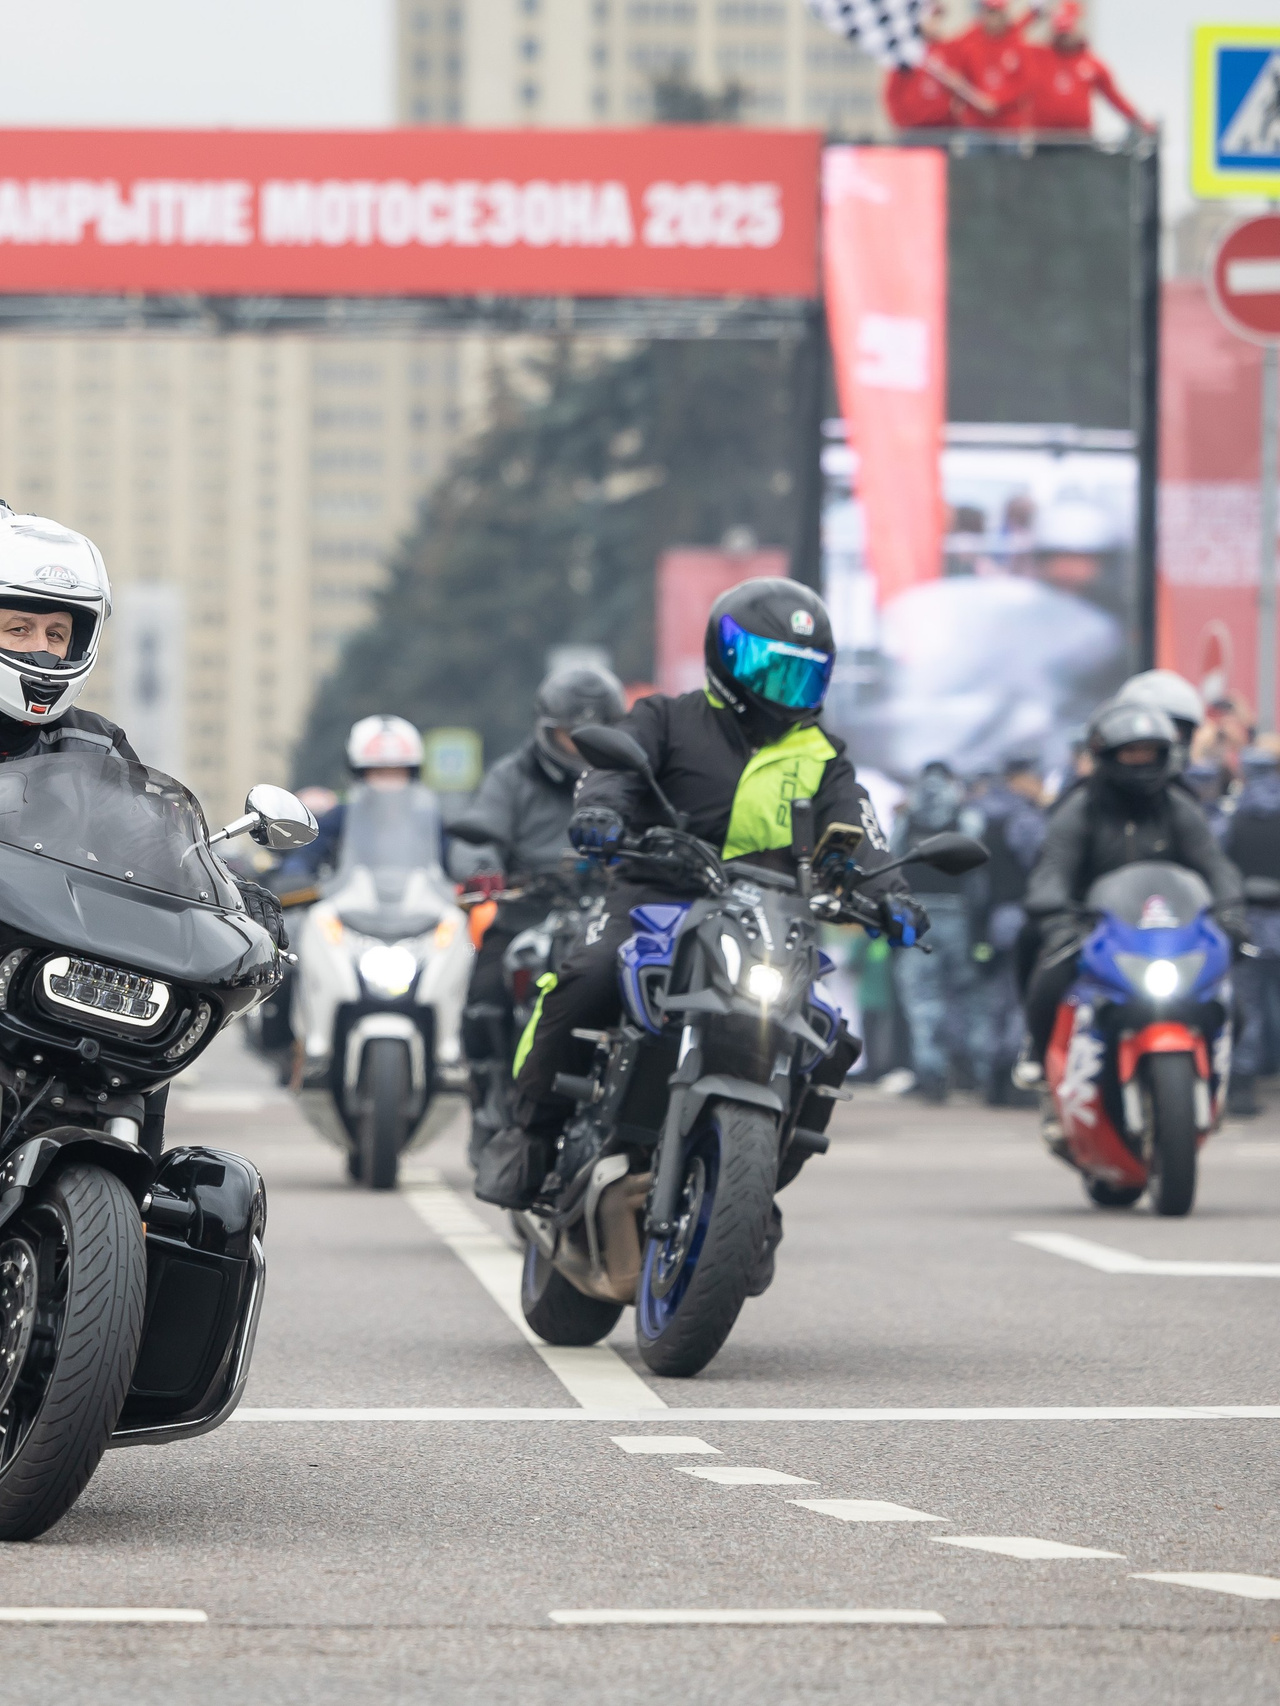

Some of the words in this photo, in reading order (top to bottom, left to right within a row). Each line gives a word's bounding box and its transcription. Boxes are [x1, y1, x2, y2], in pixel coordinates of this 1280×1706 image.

[260, 178, 635, 247] МОТОСЕЗОНА
[641, 180, 783, 248] 2025
[36, 566, 80, 586] Airoh
